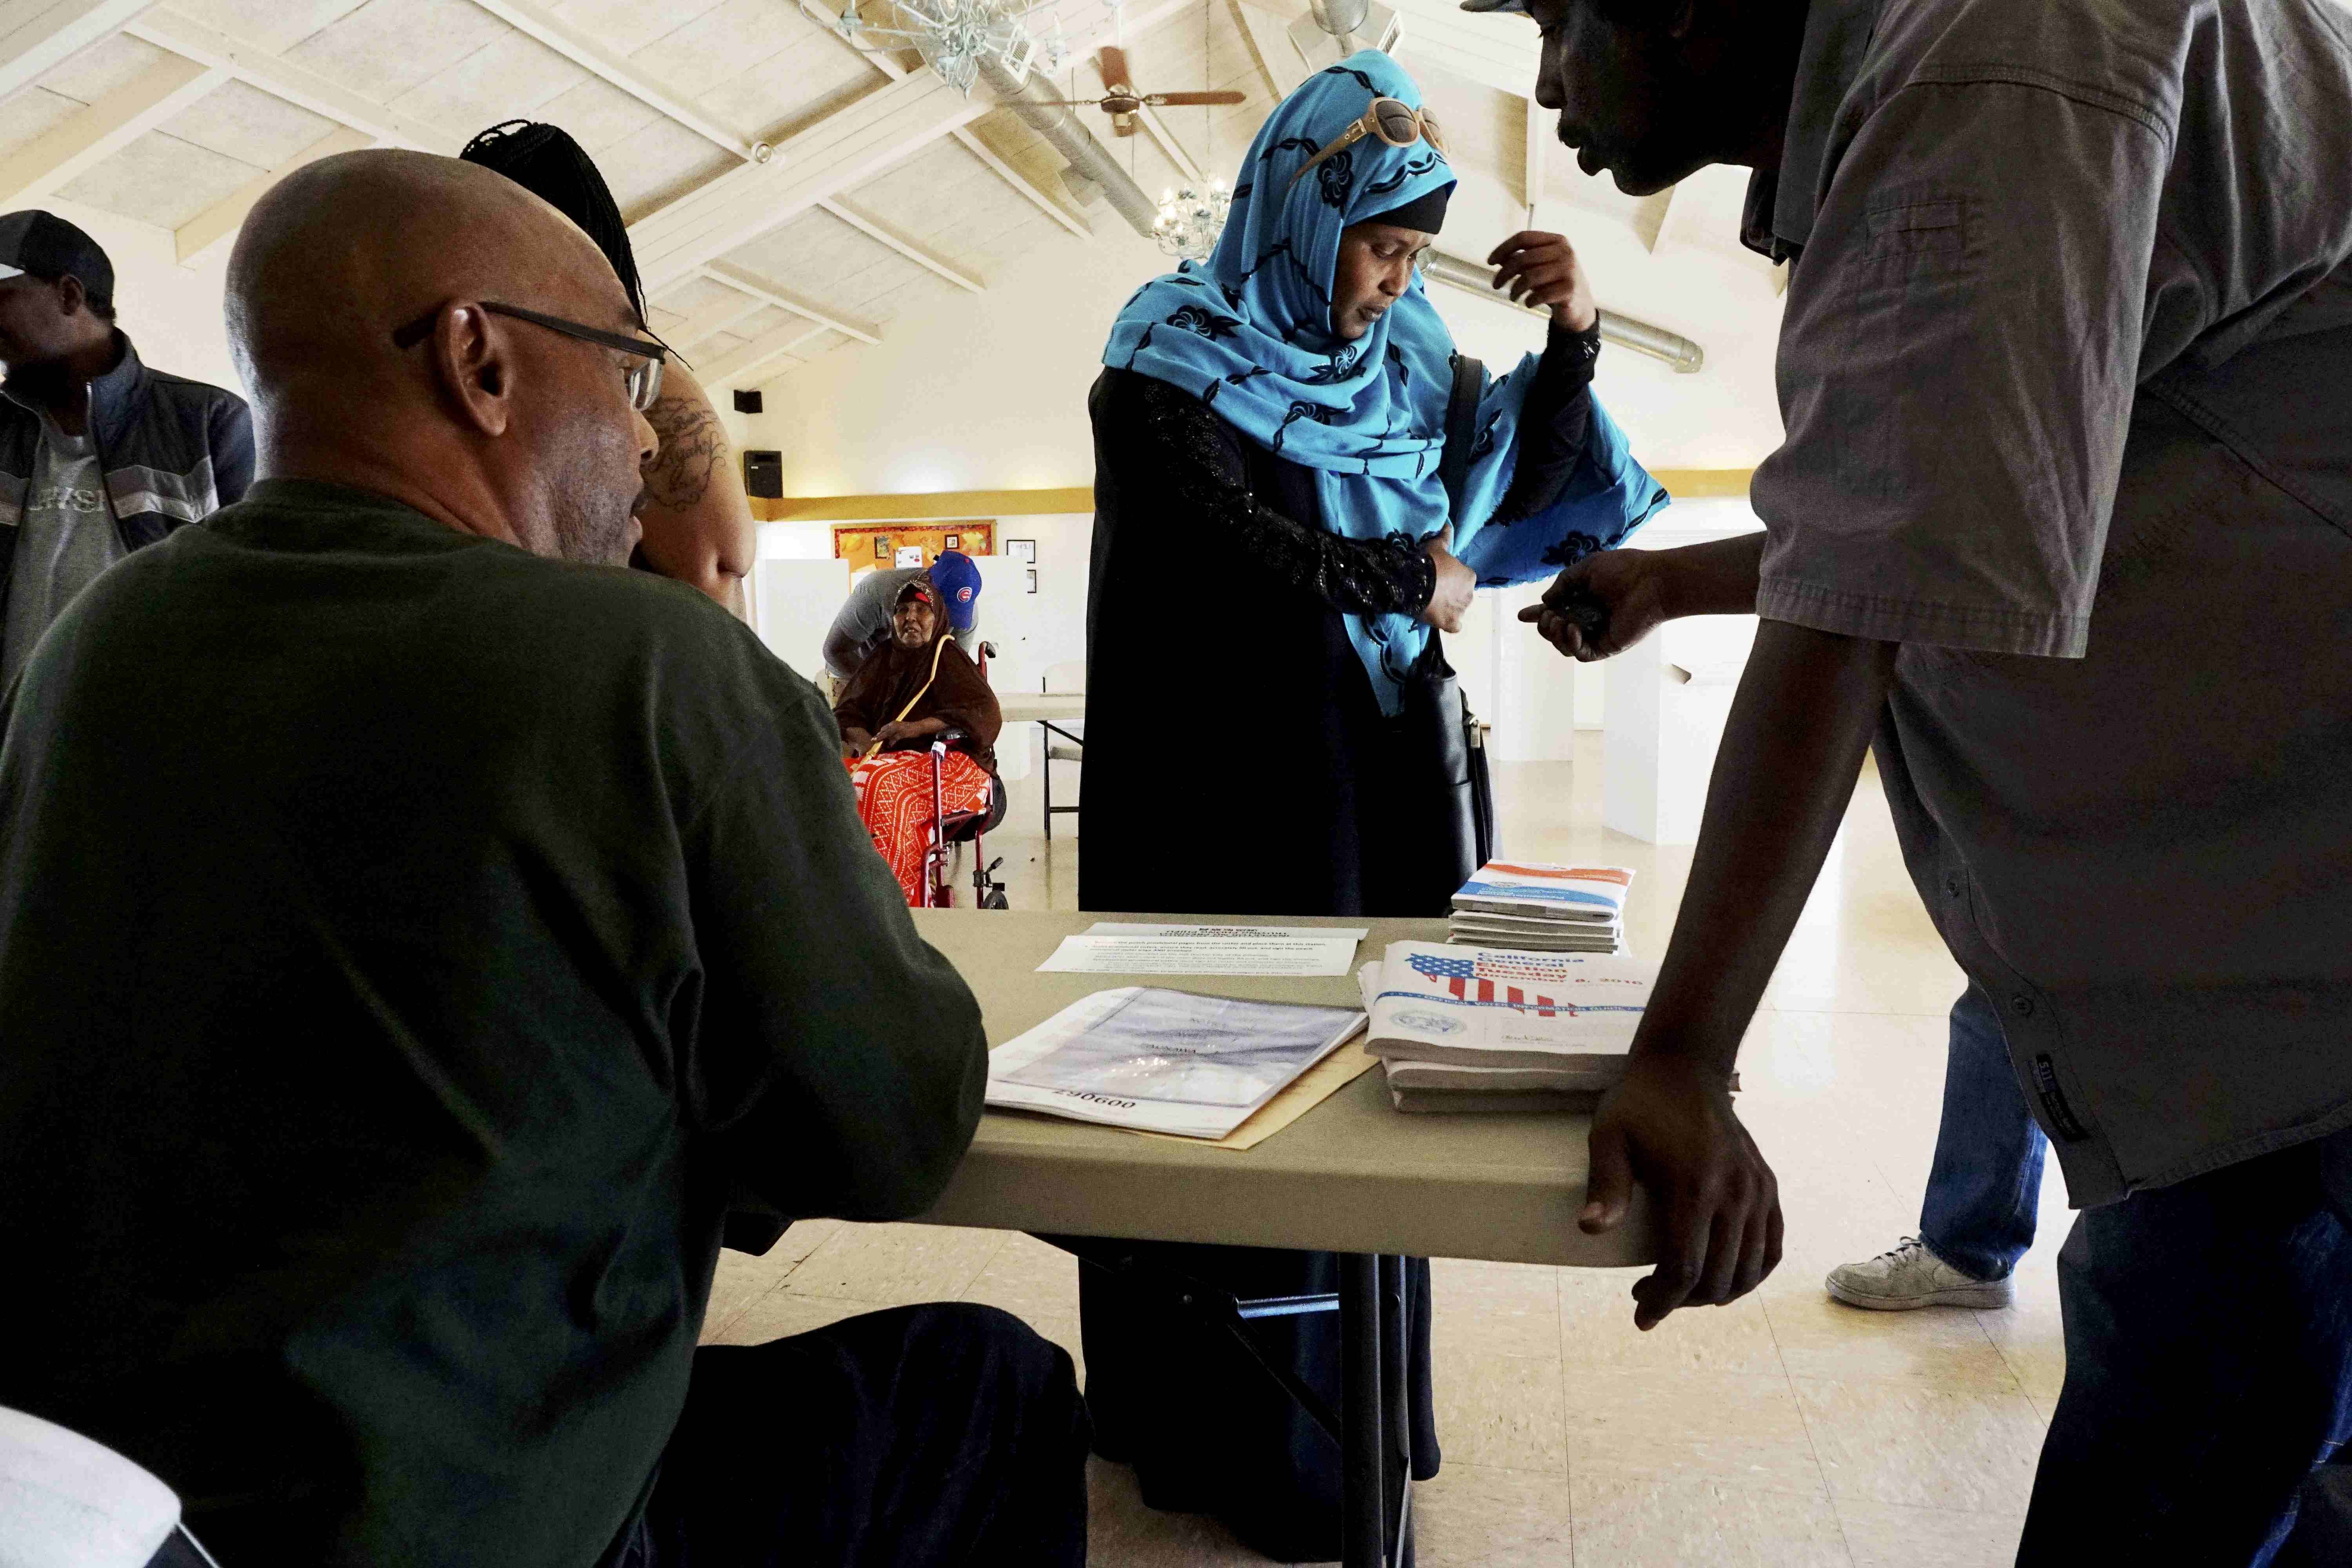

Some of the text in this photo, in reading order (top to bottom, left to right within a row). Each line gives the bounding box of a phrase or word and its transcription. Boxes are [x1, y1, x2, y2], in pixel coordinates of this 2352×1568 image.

[1477, 953, 1584, 962] California
[1477, 957, 1564, 967] General
[1476, 962, 1568, 972] Election
[1475, 973, 1566, 982] November
[1476, 967, 1567, 979] Tuesday
